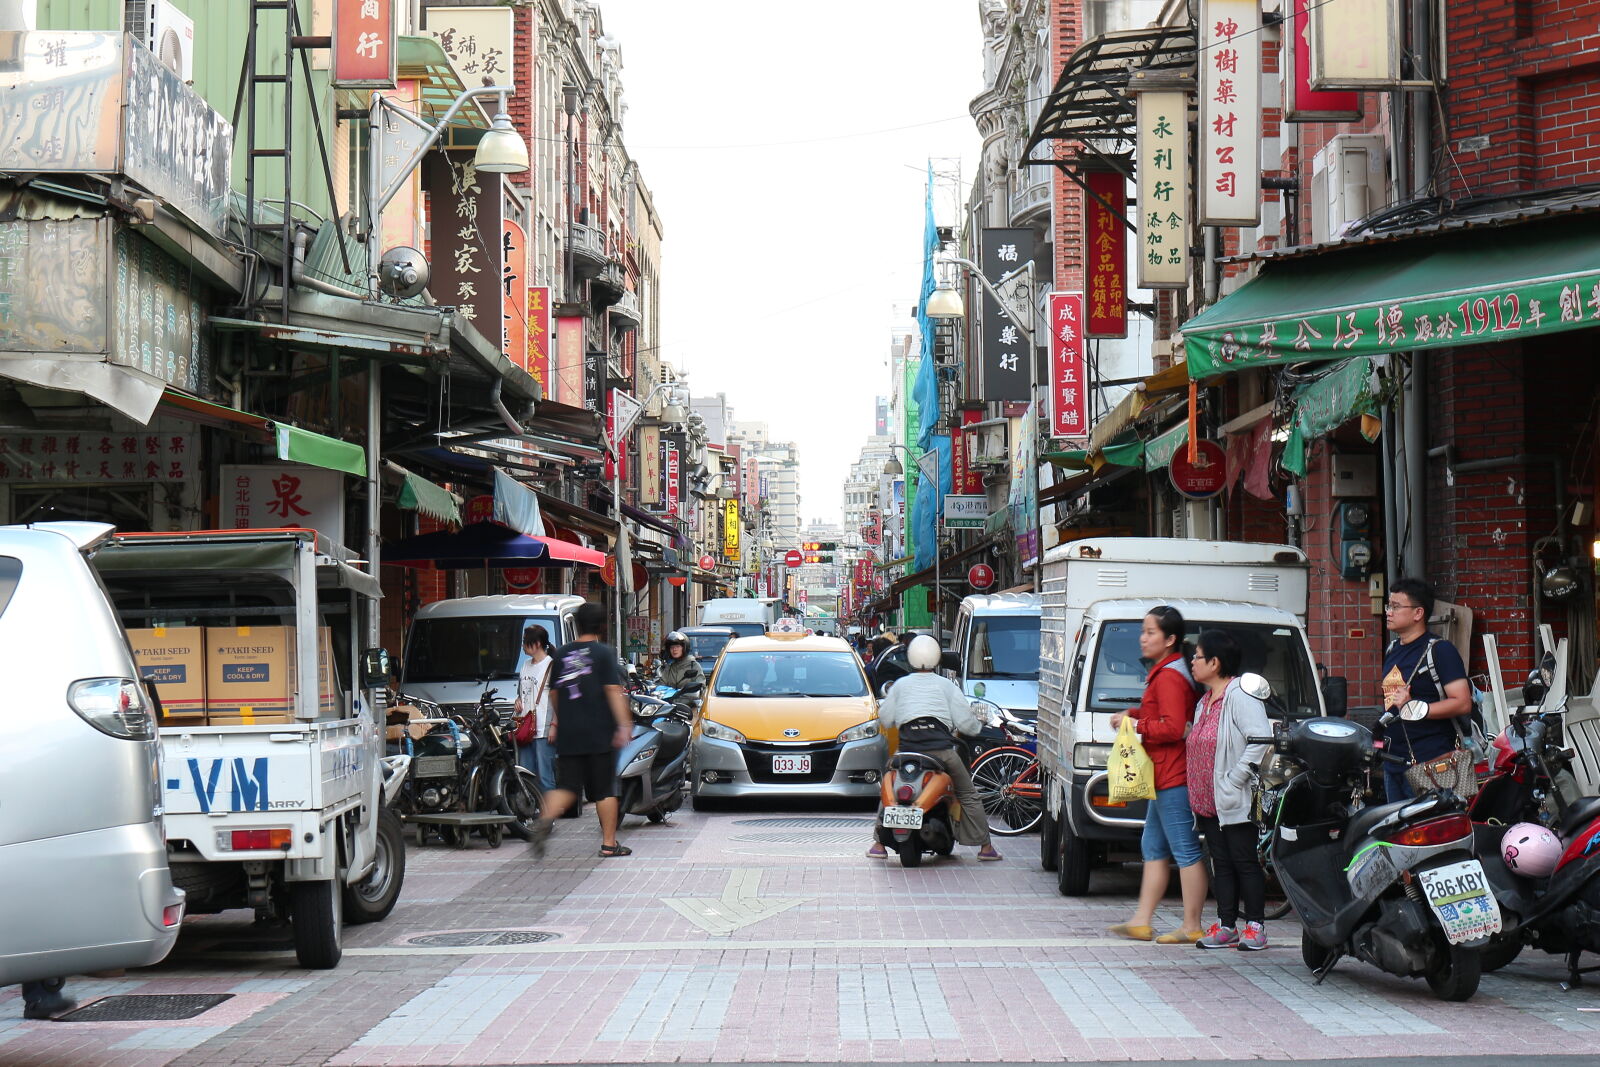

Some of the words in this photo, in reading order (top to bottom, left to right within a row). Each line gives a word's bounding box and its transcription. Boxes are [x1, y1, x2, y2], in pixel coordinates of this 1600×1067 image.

[356, 0, 383, 59] 商行
[1212, 17, 1239, 198] 坤樹藥材公司
[1151, 115, 1174, 202] 永利行
[1146, 212, 1164, 266] 添加物
[997, 244, 1020, 373] 福藥行
[1058, 303, 1080, 427] 成泰行五賢醋
[141, 648, 166, 656] TAKII
[167, 647, 190, 655] SEED
[168, 673, 182, 681] DRY
[225, 647, 250, 655] TAKII
[251, 646, 274, 654] SEED
[884, 813, 922, 826] CKL-382
